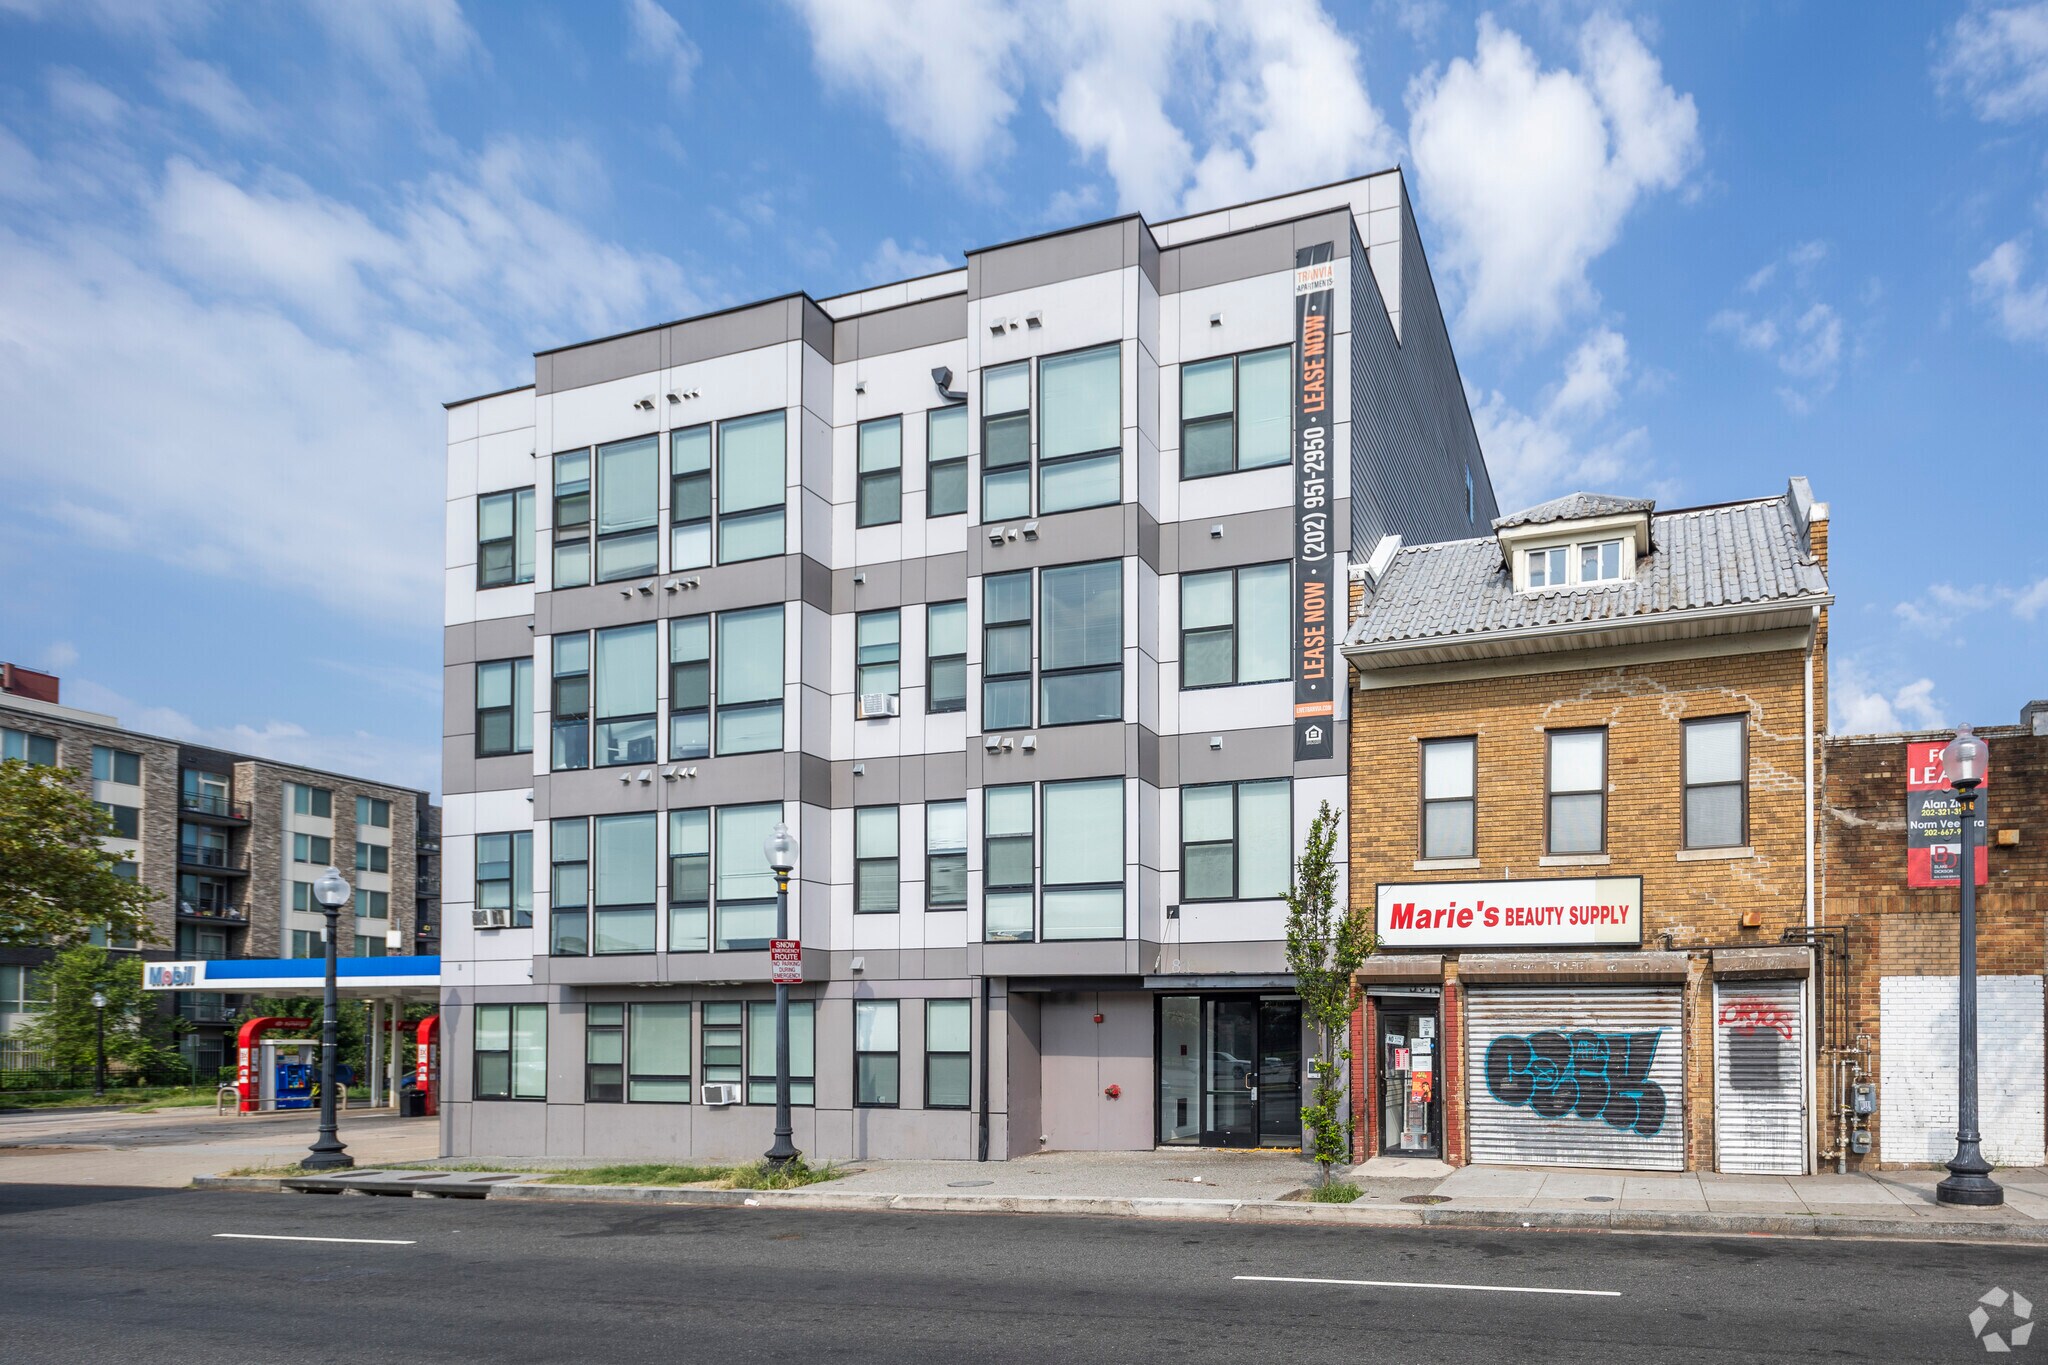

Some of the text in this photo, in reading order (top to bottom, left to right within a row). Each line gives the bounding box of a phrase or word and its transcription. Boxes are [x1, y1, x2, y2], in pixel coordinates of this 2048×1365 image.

[1297, 265, 1333, 283] TRANVIA
[1296, 278, 1333, 292] APARTMENTS
[1302, 314, 1327, 680] LEASE NOW (202) 951-2950 LEASE NOW
[1922, 800, 1947, 809] Alan
[1910, 819, 1985, 830] Norm Veera
[1923, 828, 1962, 837] 202-667-9
[1390, 900, 1629, 930] Marie's BEAUTY SUPPLY
[775, 941, 796, 949] SNOW
[149, 965, 196, 987] Mobil
